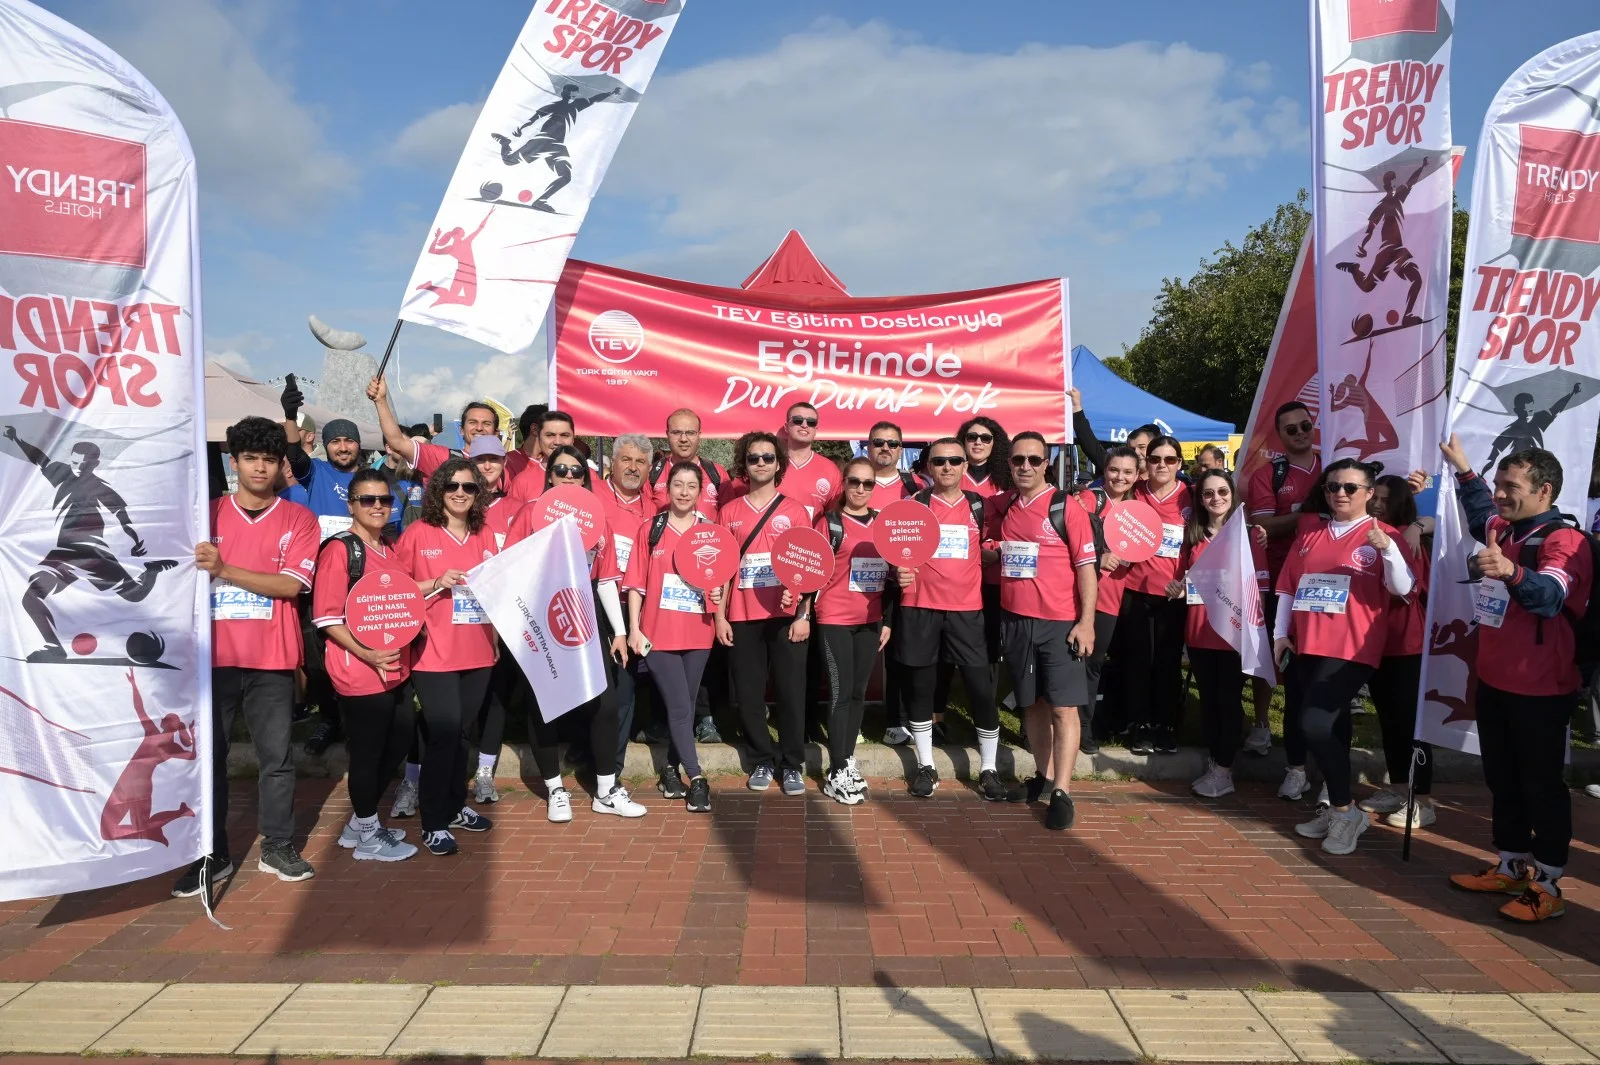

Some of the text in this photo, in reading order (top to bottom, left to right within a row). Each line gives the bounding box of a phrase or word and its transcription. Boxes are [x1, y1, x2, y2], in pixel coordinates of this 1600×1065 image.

[543, 24, 634, 75] SPOR
[1324, 62, 1444, 113] TRENDY
[1340, 104, 1426, 149] SPOR
[1525, 162, 1600, 193] TRENDY
[1472, 265, 1600, 322] TRENDY
[711, 304, 1003, 333] TEV Eğitim Dostlarıyla
[595, 337, 638, 351] TEV
[1477, 316, 1582, 366] SPOR
[757, 338, 962, 384] Eğitimde
[576, 367, 600, 375] TÜRK
[633, 369, 658, 377] VAKFI
[605, 378, 629, 386] 1967
[713, 375, 1001, 417] Dur Durak Yok
[544, 514, 554, 522] ne
[553, 499, 593, 520] Eğitim için
[584, 520, 594, 529] da
[885, 519, 927, 528] Biz koşarız,
[891, 527, 921, 536] gelecek
[1114, 512, 1134, 530] eğitim
[1133, 527, 1156, 548] aşkımız
[1122, 508, 1157, 540] Tempomuzu
[695, 531, 716, 539] TEV
[889, 535, 924, 543] şekillenir.
[1119, 525, 1141, 546] belirler.
[785, 550, 821, 568] eğitim için
[788, 542, 823, 560] Yorgunluk,
[1003, 555, 1034, 564] 12472
[1354, 554, 1374, 564] TEV
[776, 554, 804, 570] koşunca
[805, 564, 826, 577] güzel.
[855, 571, 887, 580] 12489
[356, 593, 417, 604] EĞİTİME DESTEK
[1300, 588, 1344, 598] 12487
[363, 611, 412, 622] KOŞUYORUM,
[368, 603, 384, 612] İÇİN
[357, 620, 419, 632] OYNAT BAKALIM!
[552, 597, 580, 642] TEV
[515, 596, 533, 621] TÜRK
[545, 652, 558, 680] VAKFI
[522, 630, 539, 653] 1967
